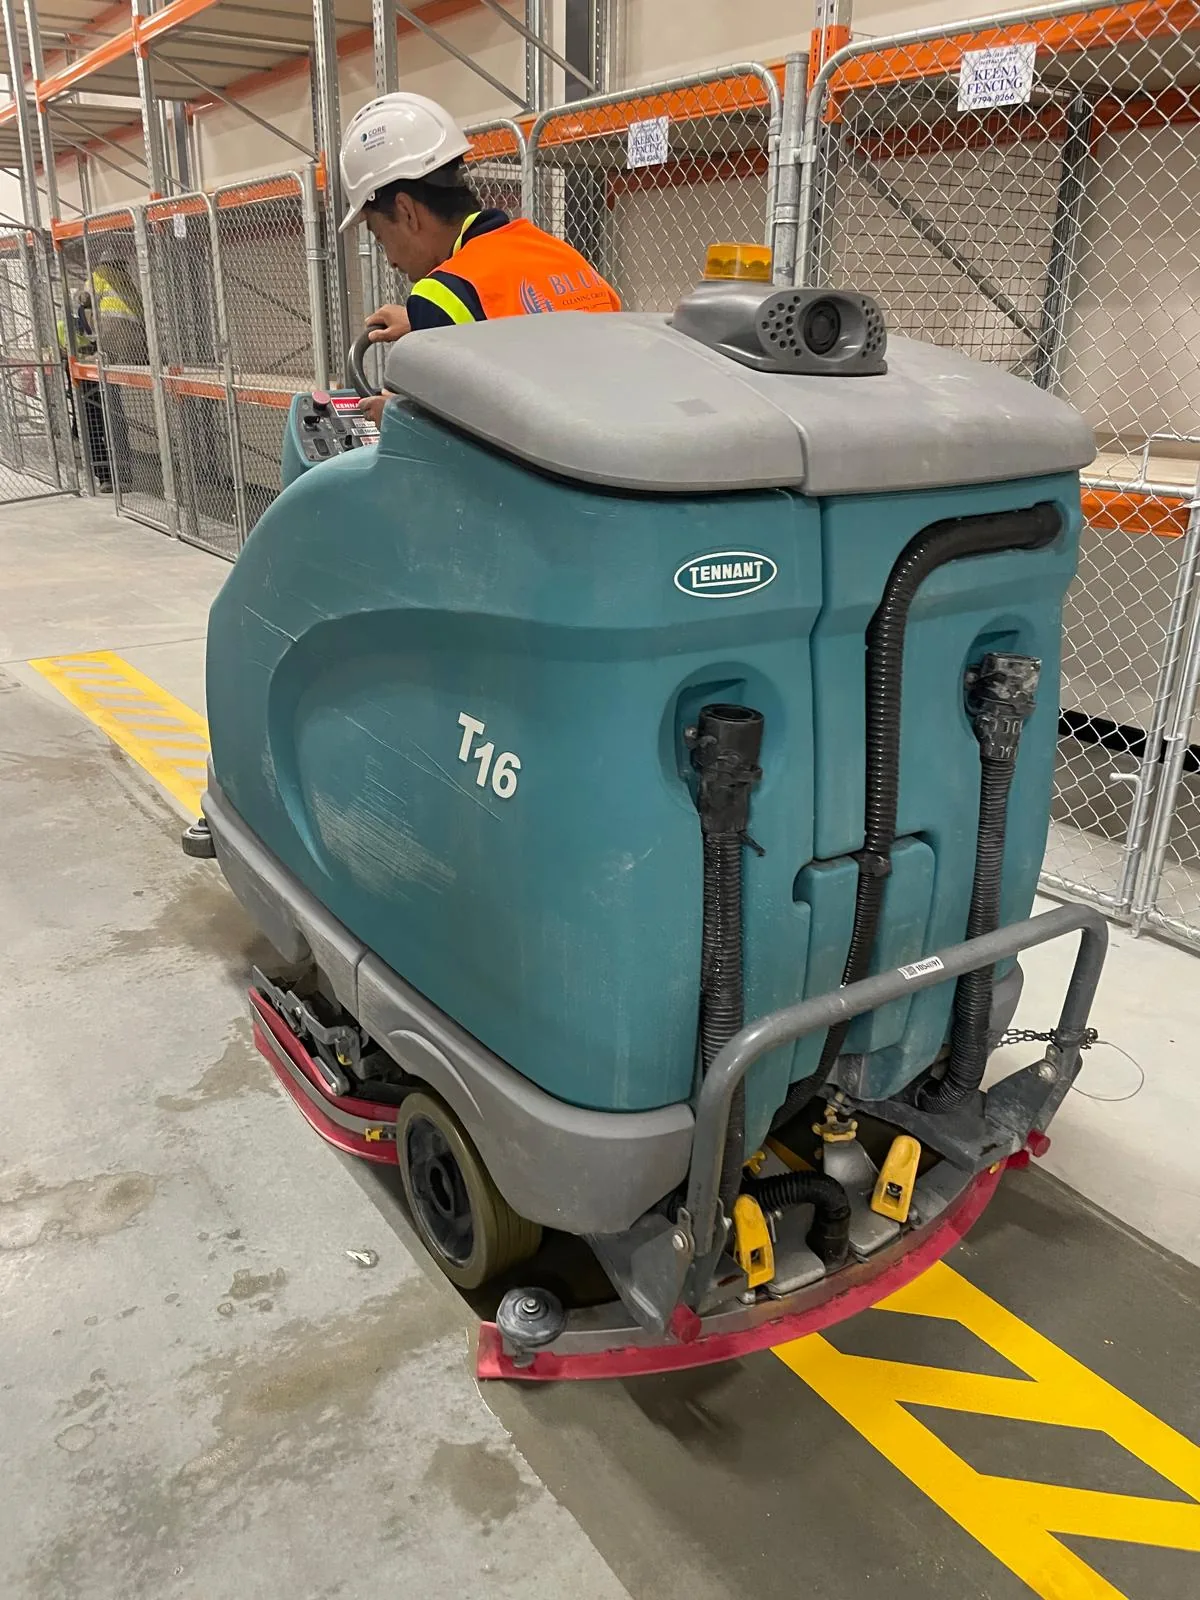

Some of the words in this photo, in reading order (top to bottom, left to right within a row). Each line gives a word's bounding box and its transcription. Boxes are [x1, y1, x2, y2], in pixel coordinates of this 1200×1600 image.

[974, 65, 1018, 81] KEENA
[966, 77, 1023, 95] FENCING
[368, 125, 386, 137] CORE
[689, 560, 764, 588] TENNANT
[457, 711, 522, 799] T16
